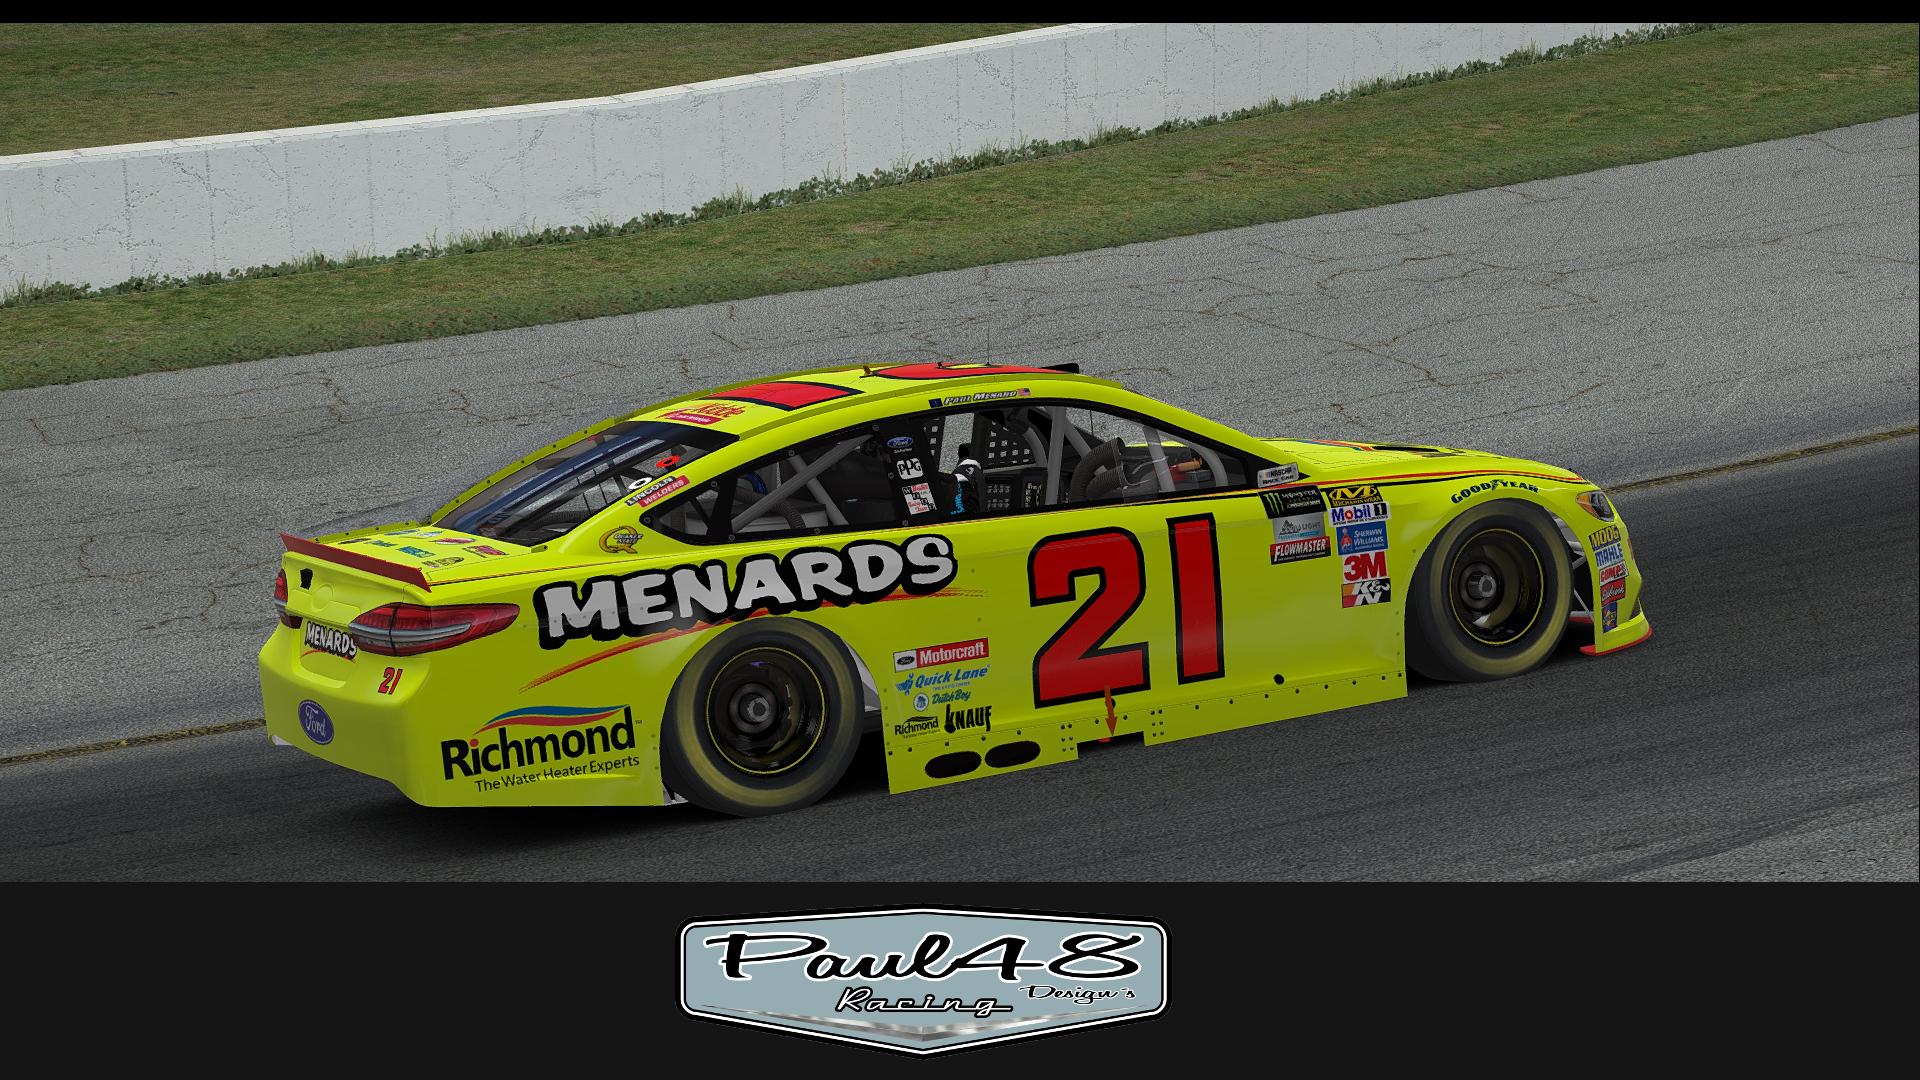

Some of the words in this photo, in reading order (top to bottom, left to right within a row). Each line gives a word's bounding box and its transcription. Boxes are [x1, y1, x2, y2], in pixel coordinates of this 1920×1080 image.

[897, 459, 921, 476] PPG
[626, 475, 675, 505] LINCOLN
[643, 478, 686, 505] WELDERS
[1450, 480, 1540, 504] GOODYEAR
[1331, 504, 1372, 522] Mobil
[1353, 536, 1385, 546] WILLIAMS
[1354, 528, 1383, 538] SHERWIN
[1590, 527, 1620, 549] MOOG
[1274, 539, 1326, 562] FLOWMASTER
[1595, 543, 1623, 567] MAHLE
[1344, 551, 1388, 581] 3M
[536, 534, 956, 646] MENARDS
[1028, 513, 1226, 709] 21
[305, 621, 357, 660] MENARDS
[919, 641, 985, 665] Motorcraft
[378, 667, 403, 695] 21
[915, 670, 952, 689] Quick
[954, 666, 988, 681] Lane
[932, 691, 955, 704] Dutch
[955, 688, 971, 702] Boy
[304, 706, 327, 738] Ford
[895, 715, 939, 736] Richmond
[440, 705, 636, 780] Richmond
[475, 779, 501, 794] The
[501, 771, 541, 788] Water
[543, 764, 588, 781] Heater
[589, 754, 640, 776] Experts
